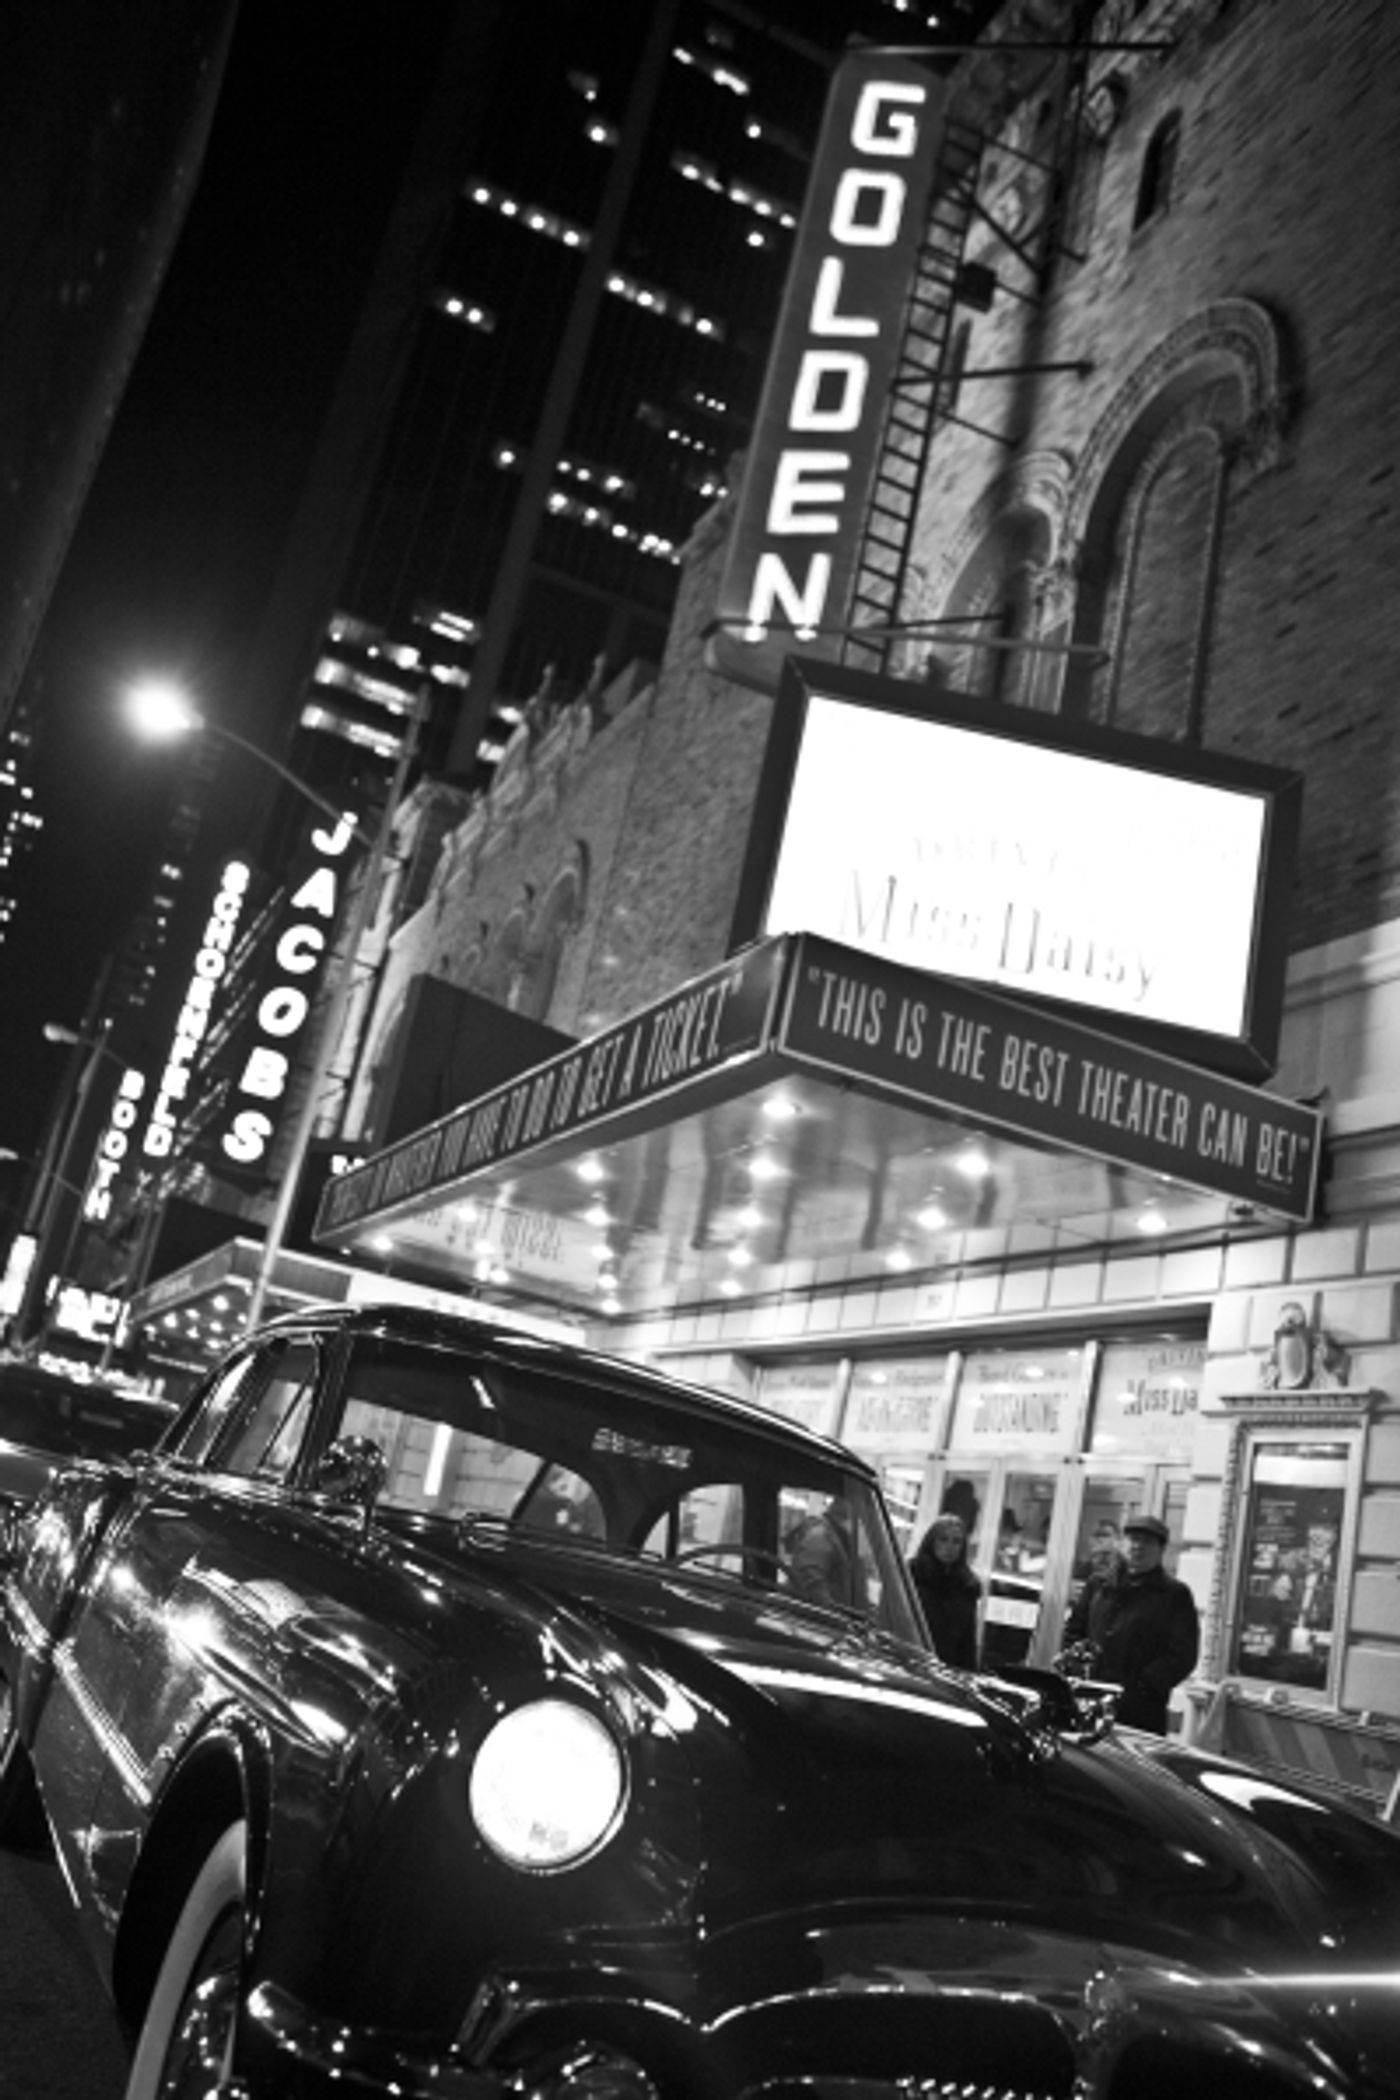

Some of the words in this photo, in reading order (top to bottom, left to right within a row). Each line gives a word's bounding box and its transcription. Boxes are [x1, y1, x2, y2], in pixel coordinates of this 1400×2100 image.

[746, 80, 926, 642] GOLDEN
[143, 861, 250, 1157] SCHOENFELD
[222, 811, 358, 1163] JACOBS
[838, 867, 984, 951] Miss
[998, 899, 1164, 1003] Daisy
[84, 1067, 145, 1220] BOOTH
[577, 1032, 626, 1118] GET
[617, 1022, 643, 1098] A
[806, 967, 888, 1047] "THIS
[894, 996, 930, 1061] IS
[937, 1009, 992, 1081] THE
[1000, 1033, 1069, 1108] BEST
[1077, 1058, 1191, 1149] THEATER
[1197, 1101, 1249, 1168] CAN
[1254, 1121, 1311, 1185] BE!"
